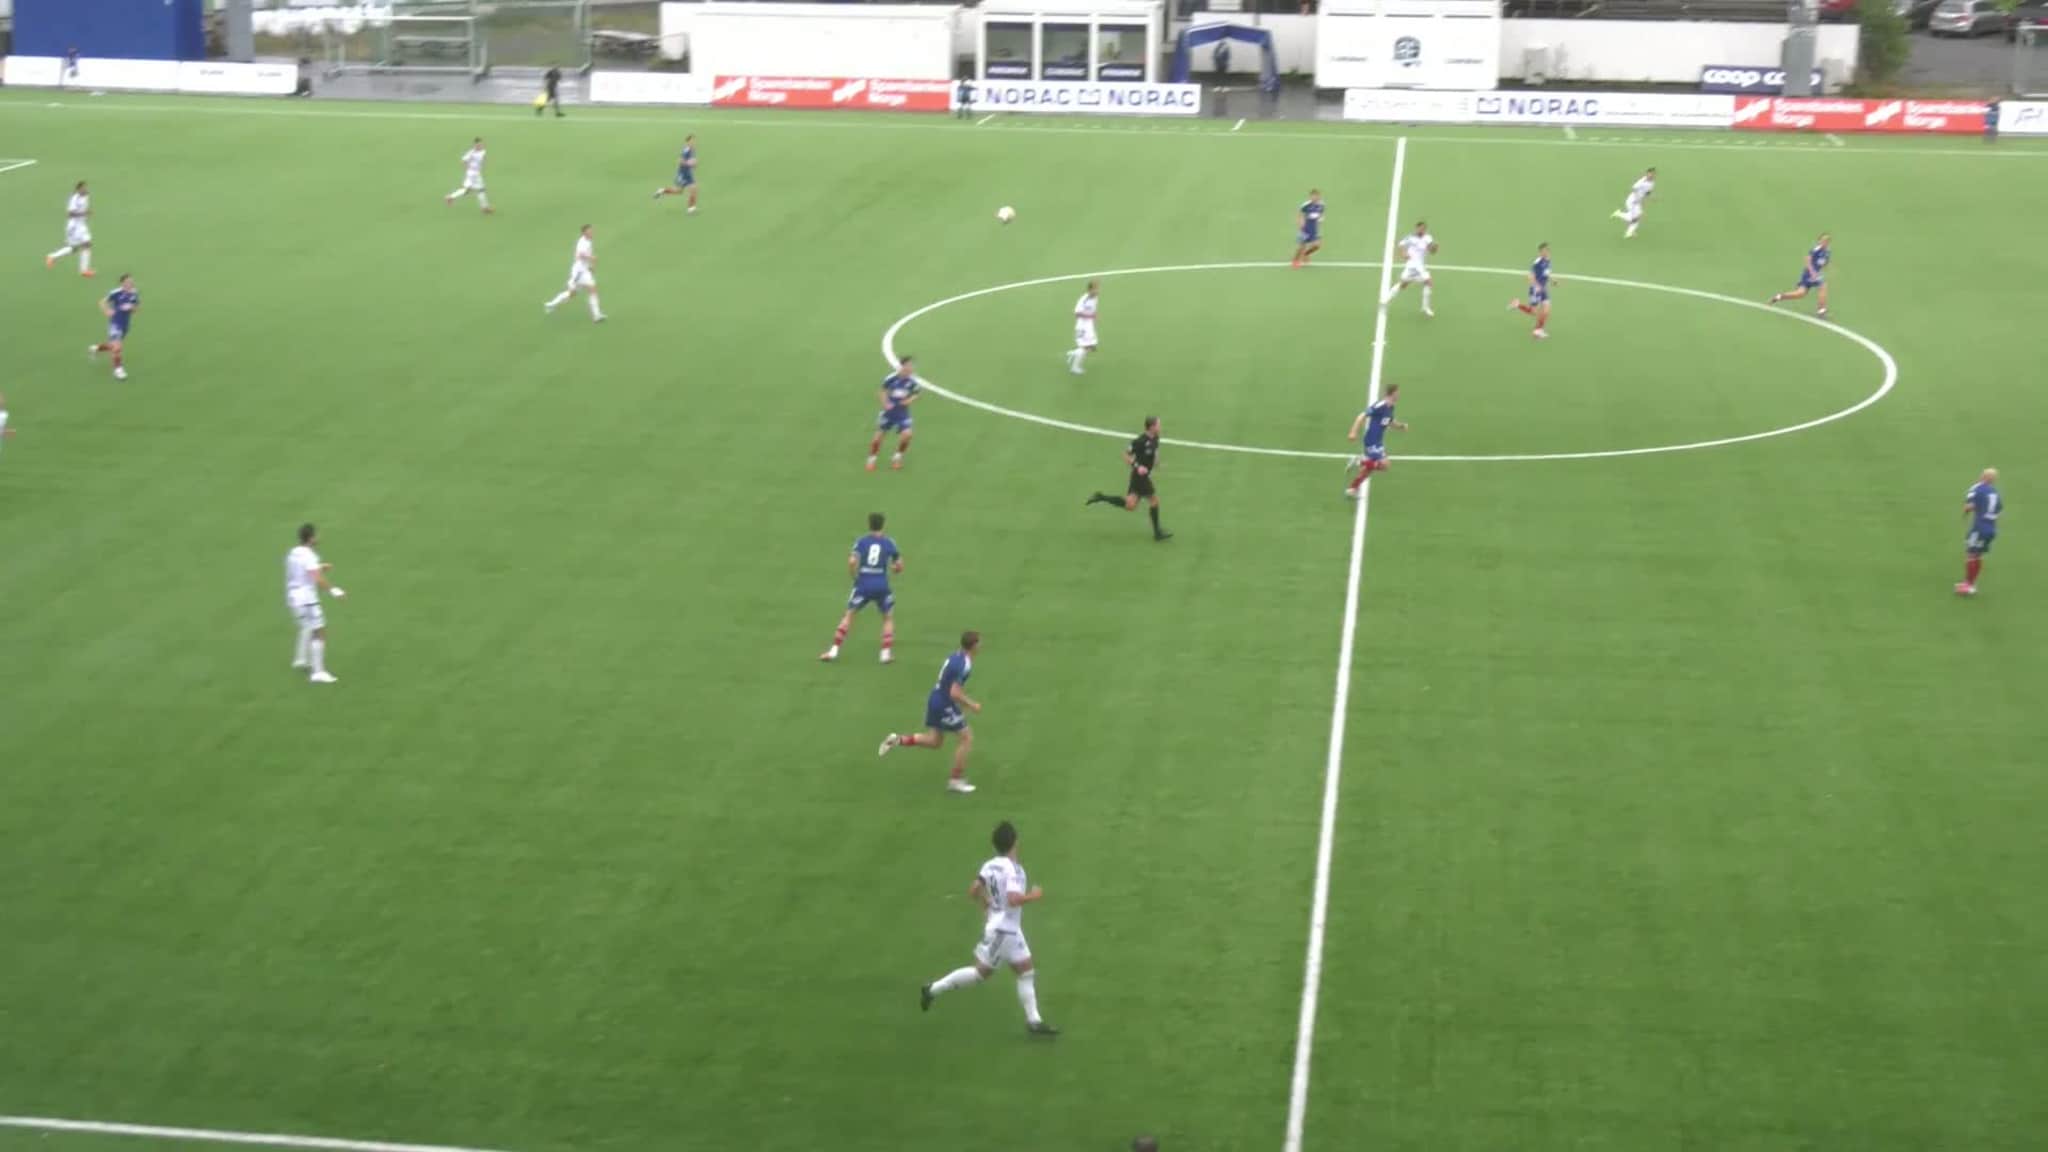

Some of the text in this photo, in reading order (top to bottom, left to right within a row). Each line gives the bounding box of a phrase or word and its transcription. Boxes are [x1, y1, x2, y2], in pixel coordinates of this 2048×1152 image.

[986, 87, 1195, 107] NORAC NORAC
[1508, 97, 1598, 116] NORAC
[867, 543, 881, 566] 8
